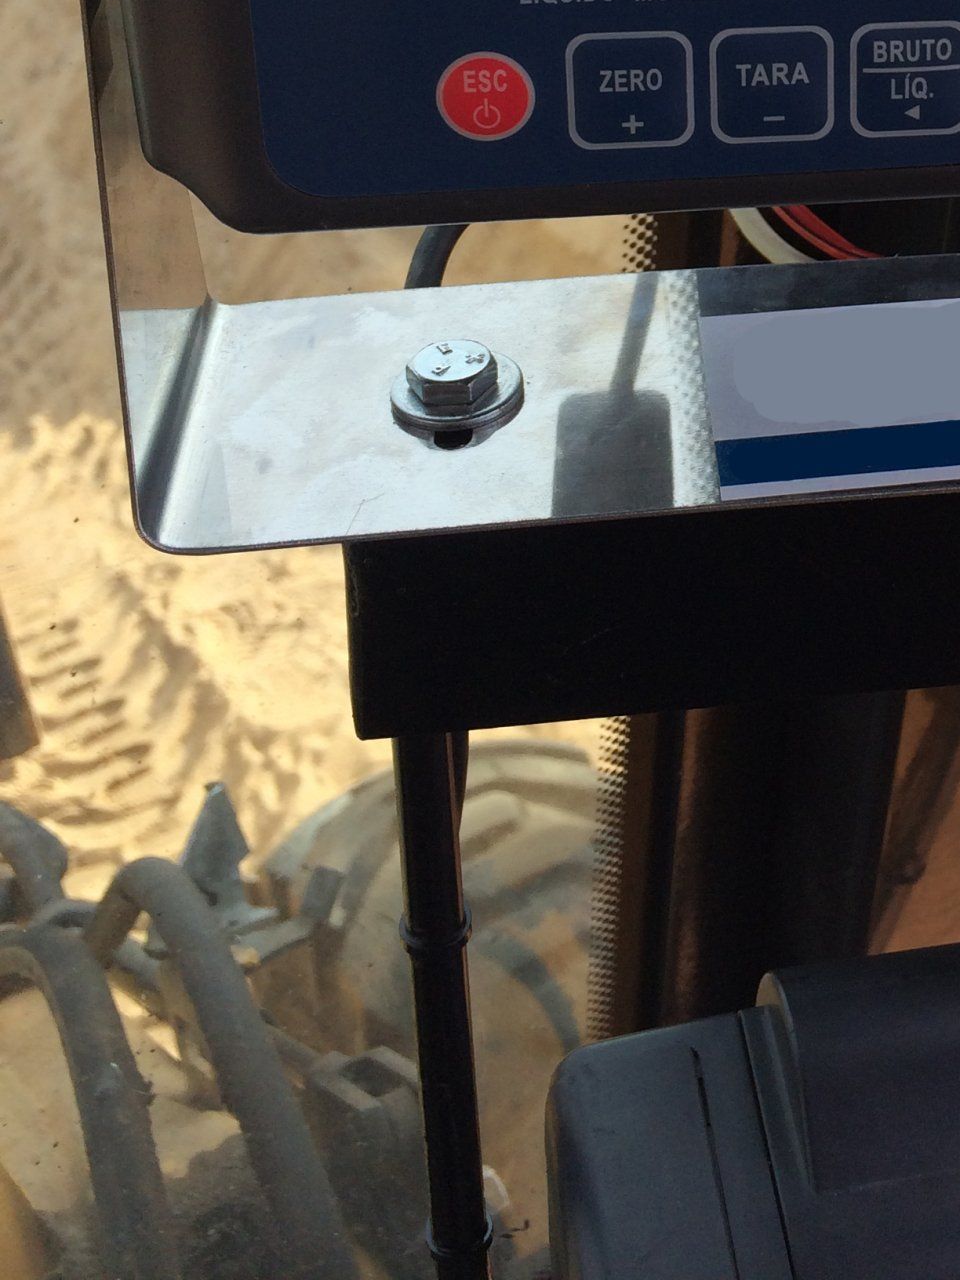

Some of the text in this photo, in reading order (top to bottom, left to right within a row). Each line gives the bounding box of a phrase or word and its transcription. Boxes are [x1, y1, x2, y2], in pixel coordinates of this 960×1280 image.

[873, 38, 953, 64] BRUTO
[463, 69, 508, 93] ESC
[600, 68, 663, 93] ZERO
[736, 62, 810, 87] TARA
[890, 73, 934, 100] LÍQ.
